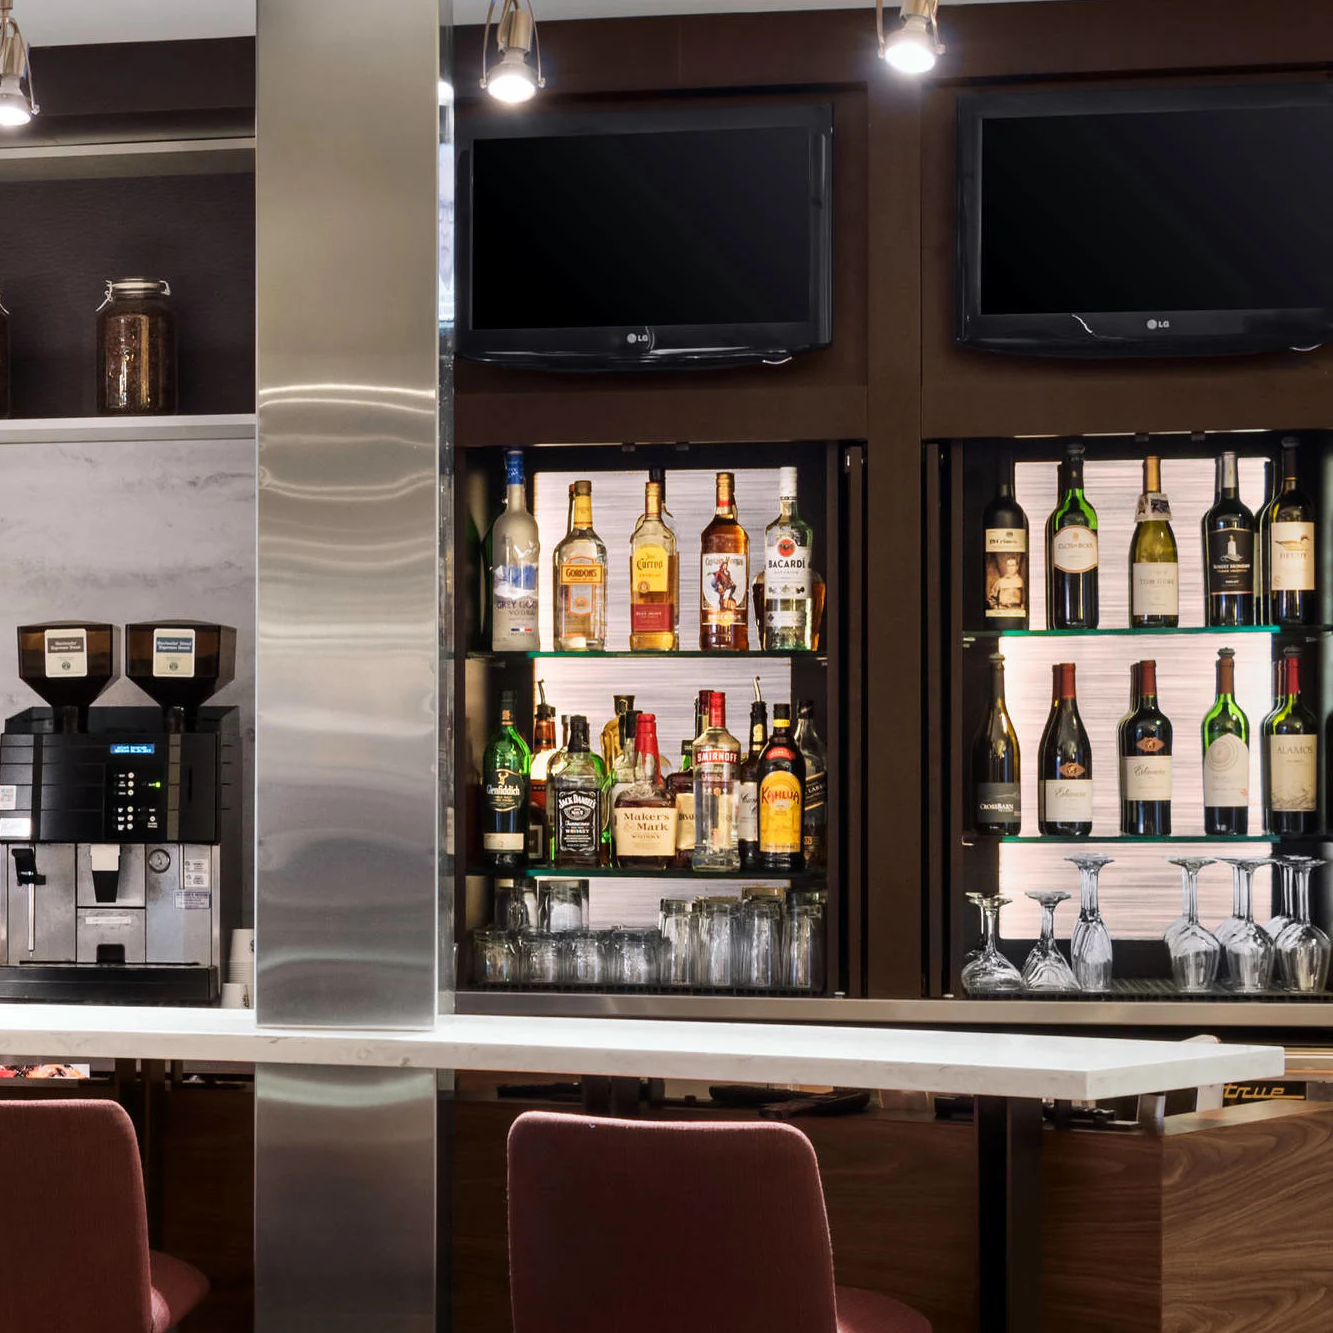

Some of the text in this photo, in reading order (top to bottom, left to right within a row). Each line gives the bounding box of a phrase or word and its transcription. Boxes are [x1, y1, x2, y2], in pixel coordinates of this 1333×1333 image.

[1158, 320, 1170, 328] LG
[637, 334, 648, 342] LG
[636, 558, 663, 571] Cuervo
[496, 600, 517, 610] GREY
[1276, 745, 1313, 756] ALAMOS
[697, 752, 738, 763] SMIRNOFF
[487, 783, 520, 796] Glenfiddich
[558, 796, 573, 809] JACK
[623, 811, 670, 822] Maker's
[636, 822, 669, 831] Mark
[1223, 1083, 1291, 1099] true
